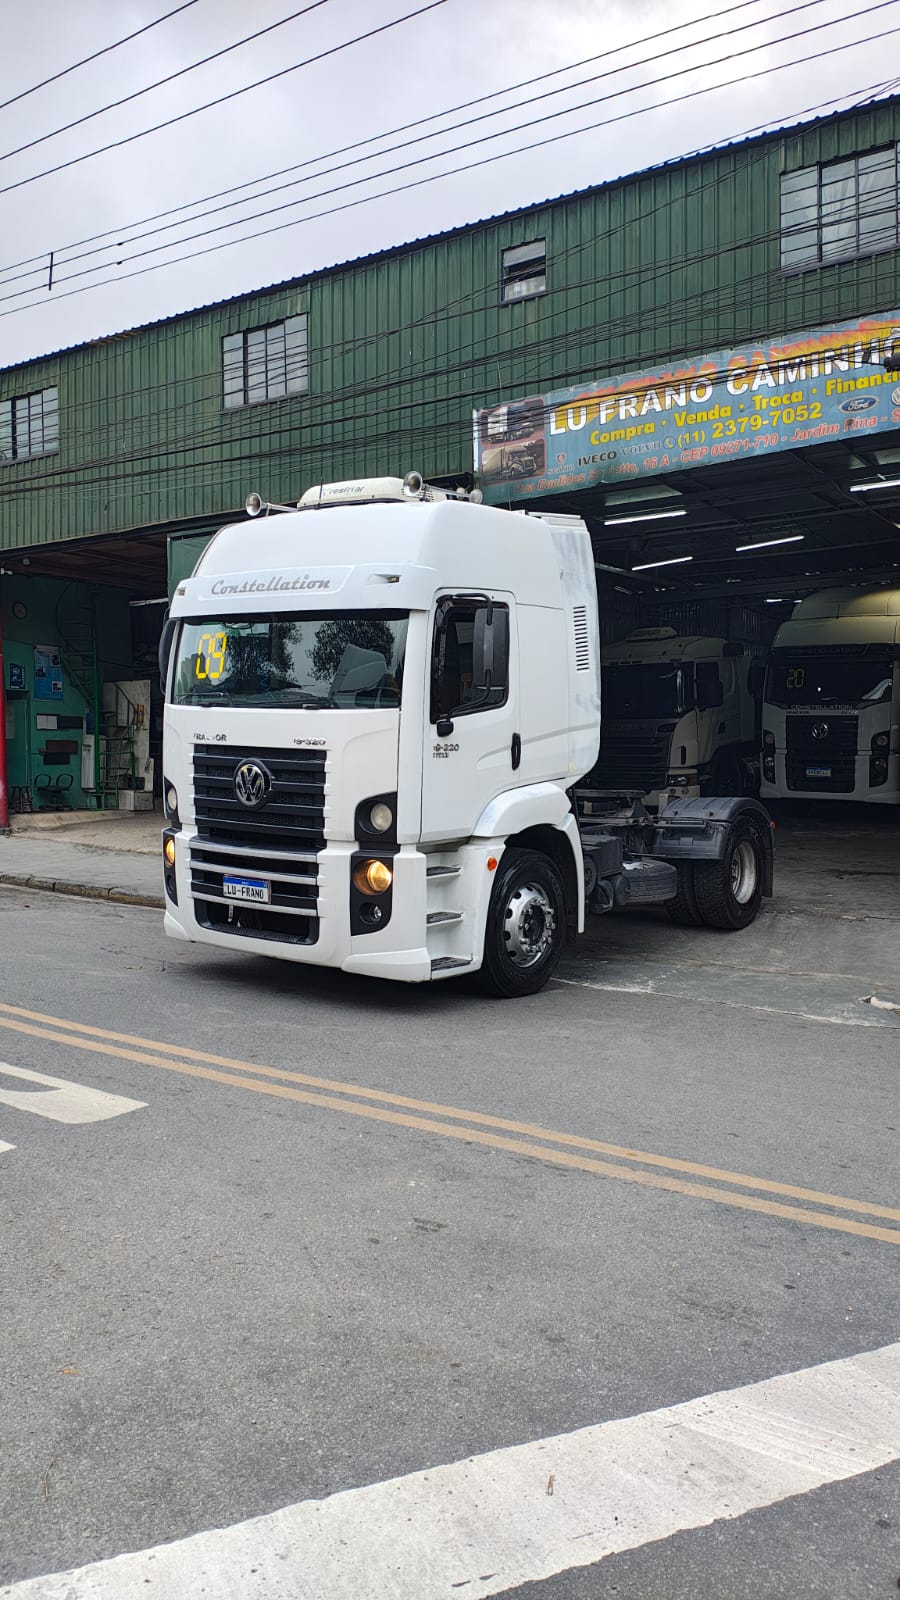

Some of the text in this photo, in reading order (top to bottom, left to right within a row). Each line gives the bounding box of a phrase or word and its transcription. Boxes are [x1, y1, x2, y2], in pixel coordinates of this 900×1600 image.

[549, 406, 587, 436] LU
[600, 377, 713, 425] FRANO
[590, 371, 900, 445] Compra Venda Troca Financi
[677, 402, 823, 448] (11) 2379-7052
[538, 473, 585, 490] Euclides
[659, 454, 670, 467] A
[680, 446, 709, 464] CEP
[790, 422, 839, 442] Jardim
[578, 451, 617, 466] IVECO
[211, 574, 331, 595] Constellation
[195, 632, 227, 679] 09
[786, 669, 804, 688] 20
[227, 884, 264, 899] LU-FRANO
